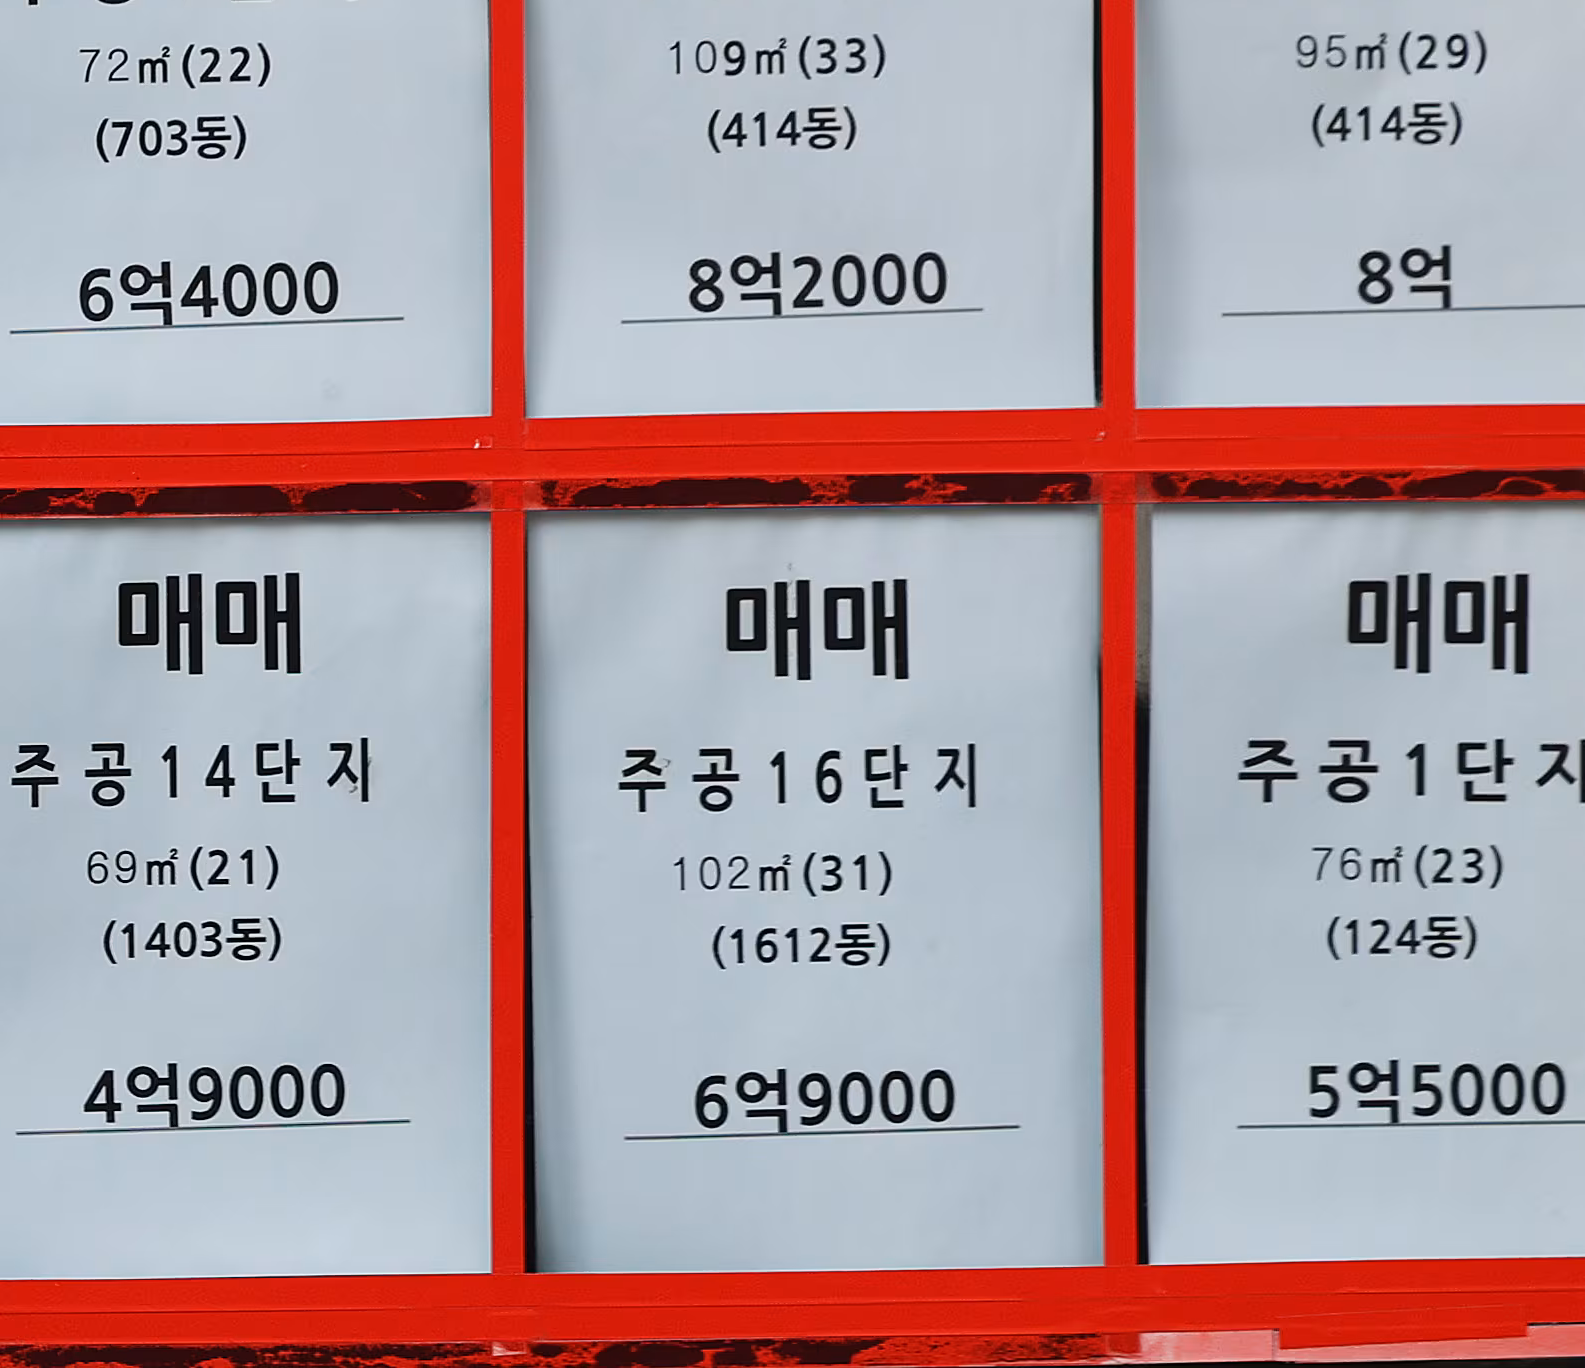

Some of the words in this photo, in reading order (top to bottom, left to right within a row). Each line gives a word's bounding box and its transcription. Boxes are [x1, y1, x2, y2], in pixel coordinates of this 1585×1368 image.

[96, 115, 246, 163] (703동)
[708, 106, 856, 153] (414동)
[1312, 102, 1462, 147] (414동)
[80, 261, 338, 328] 6억4000
[690, 252, 947, 318] 8억2000
[1359, 245, 1451, 311] 8억
[118, 573, 301, 675] 매매
[726, 579, 909, 680] 매매
[1347, 573, 1529, 674] 매매
[11, 738, 371, 807] 주공14단지
[618, 743, 976, 812] 주공16단지
[103, 917, 281, 964] (1403동)
[712, 923, 890, 969] (1612동)
[1327, 916, 1477, 960] (124동)
[85, 1063, 345, 1131] 4억9000
[695, 1069, 955, 1136] 6억9000
[1310, 1060, 1566, 1126] 5억5000
